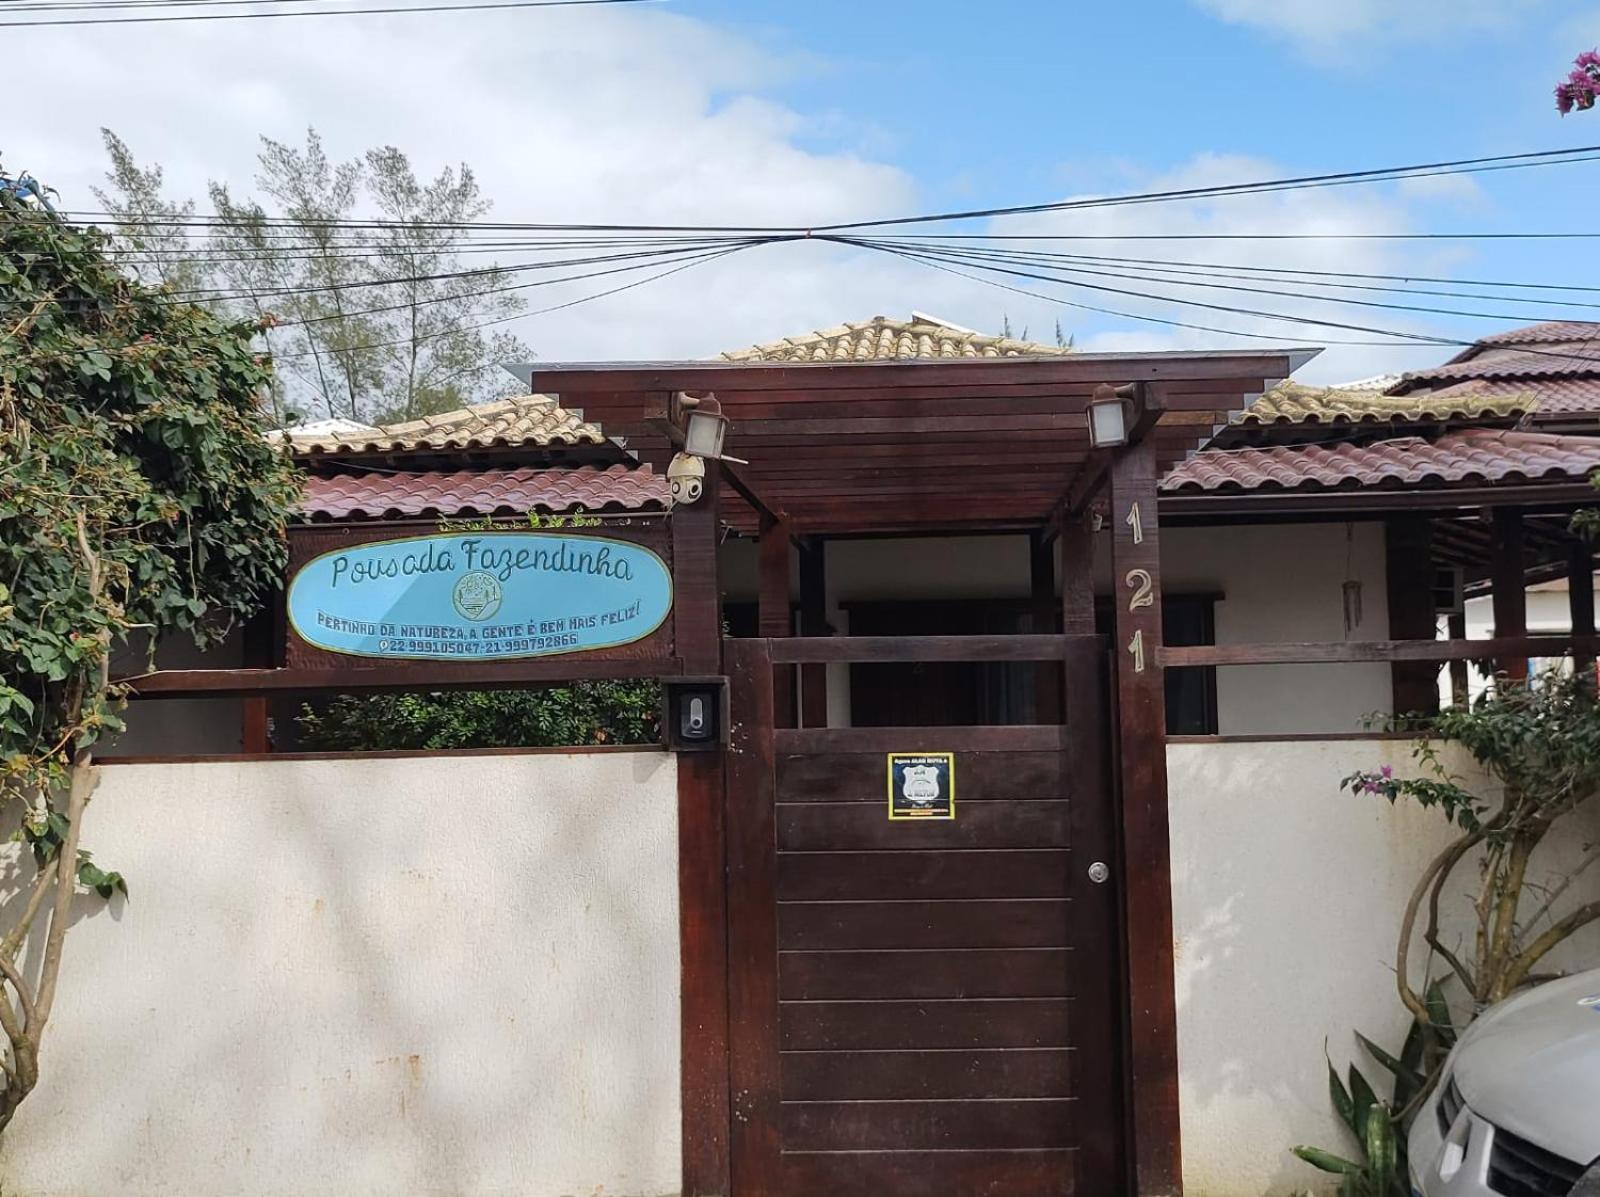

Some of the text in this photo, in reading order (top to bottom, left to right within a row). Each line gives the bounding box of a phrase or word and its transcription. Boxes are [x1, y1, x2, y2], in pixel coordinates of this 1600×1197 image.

[332, 539, 633, 588] Pousada Fazendinha
[1125, 501, 1154, 673] 121
[317, 610, 375, 636] PERTINHO
[380, 624, 396, 637] DA
[482, 624, 522, 639] GENTE
[540, 619, 564, 635] BEM
[569, 615, 596, 630] MAIS
